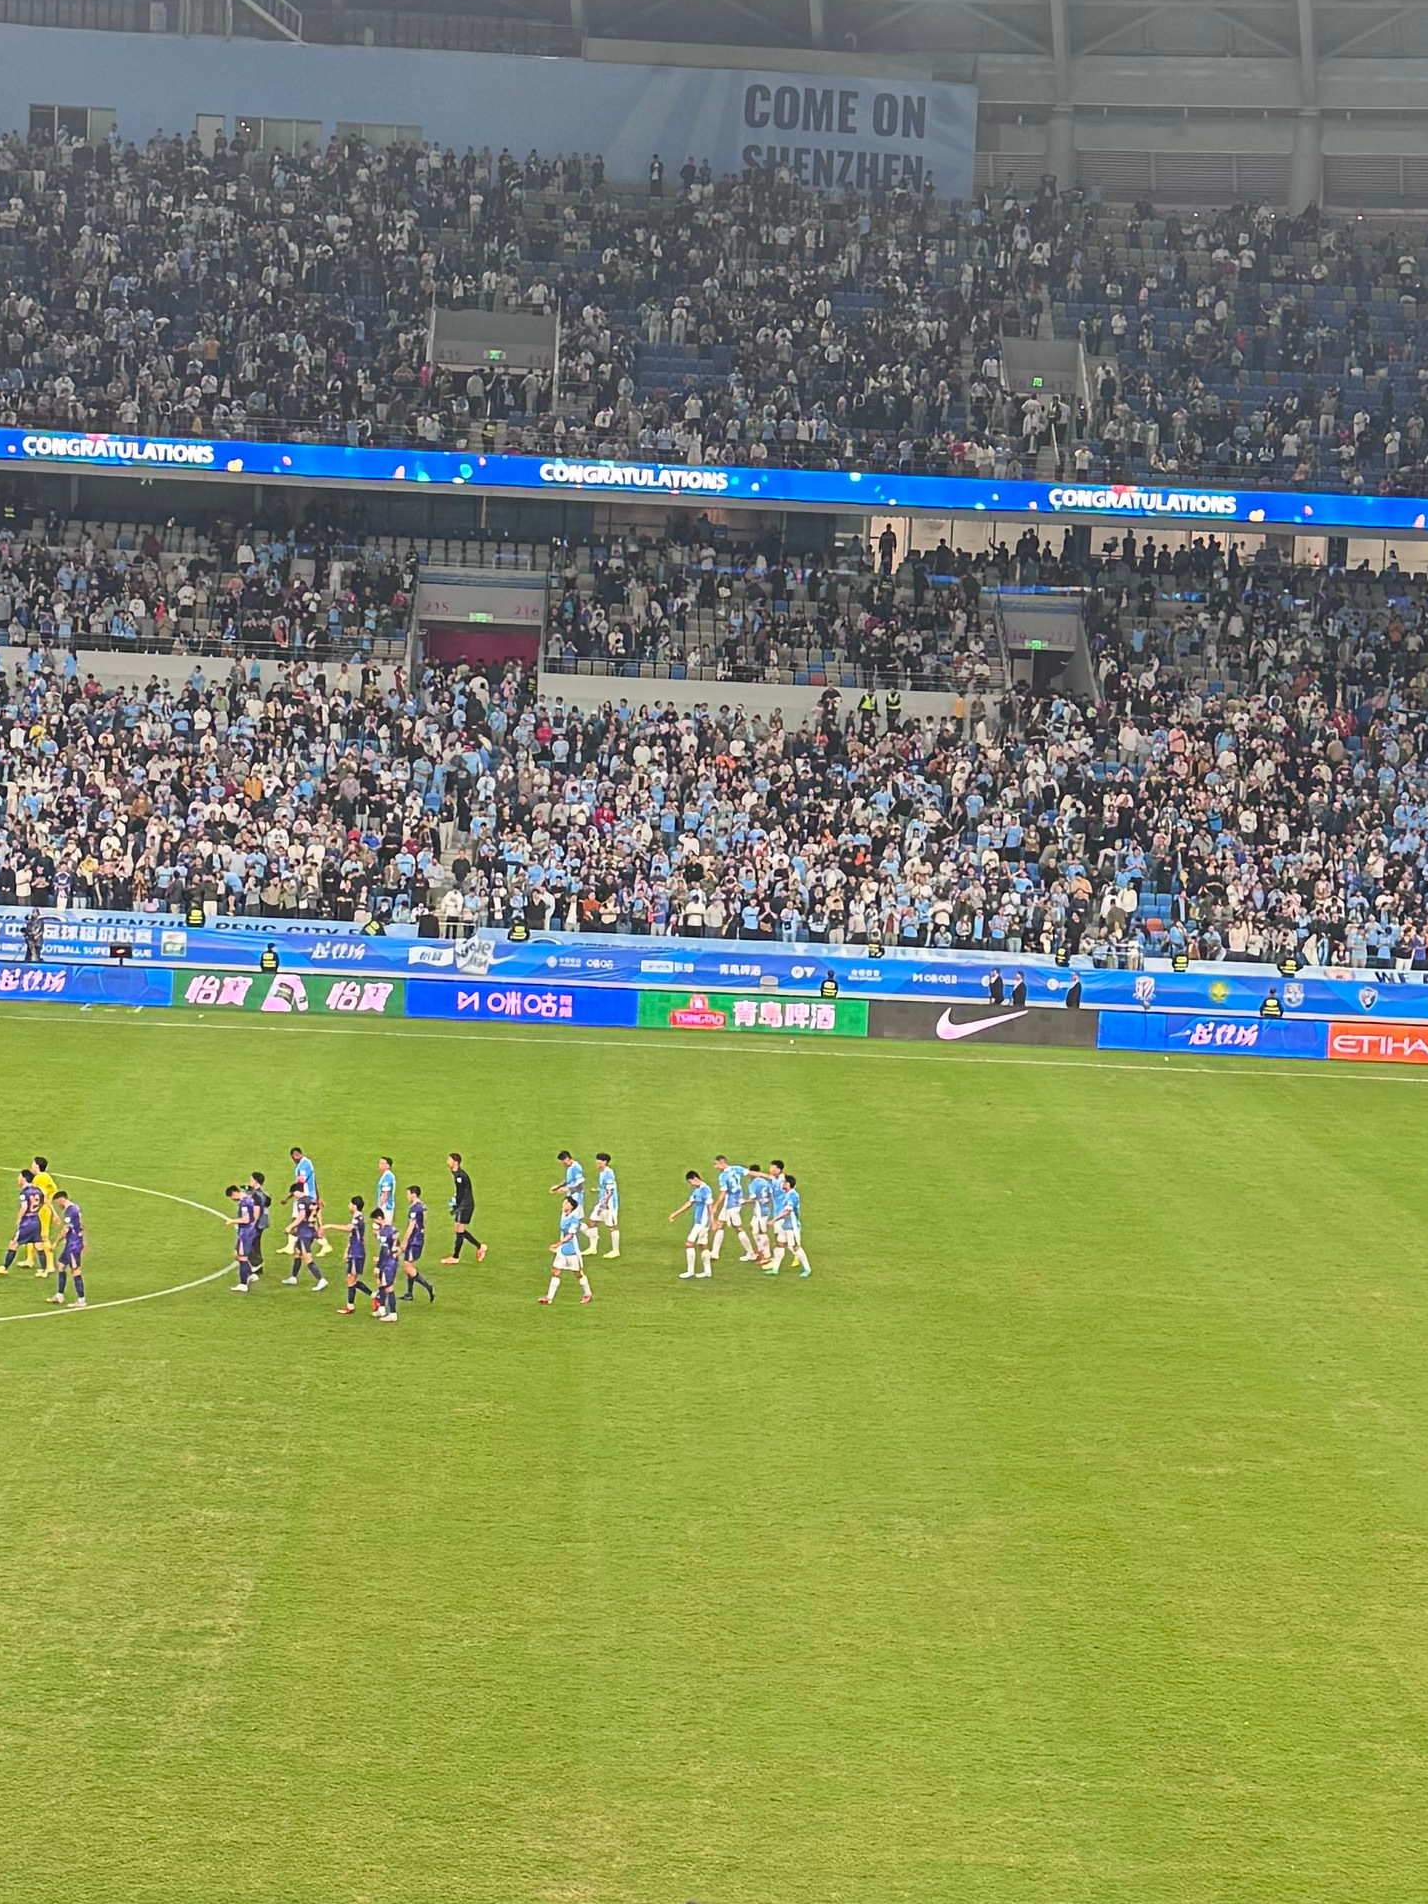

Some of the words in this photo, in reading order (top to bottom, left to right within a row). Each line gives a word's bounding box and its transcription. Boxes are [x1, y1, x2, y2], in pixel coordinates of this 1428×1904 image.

[744, 84, 859, 135] COME
[873, 92, 926, 139] ON
[23, 435, 214, 464] CONGRATULATIONS
[539, 462, 728, 490] CONGRATULATIONS
[1048, 488, 1237, 515] CONGRATULATIONS
[5, 923, 152, 944] 中足球超级联赛
[732, 999, 837, 1030] 青岛啤酒
